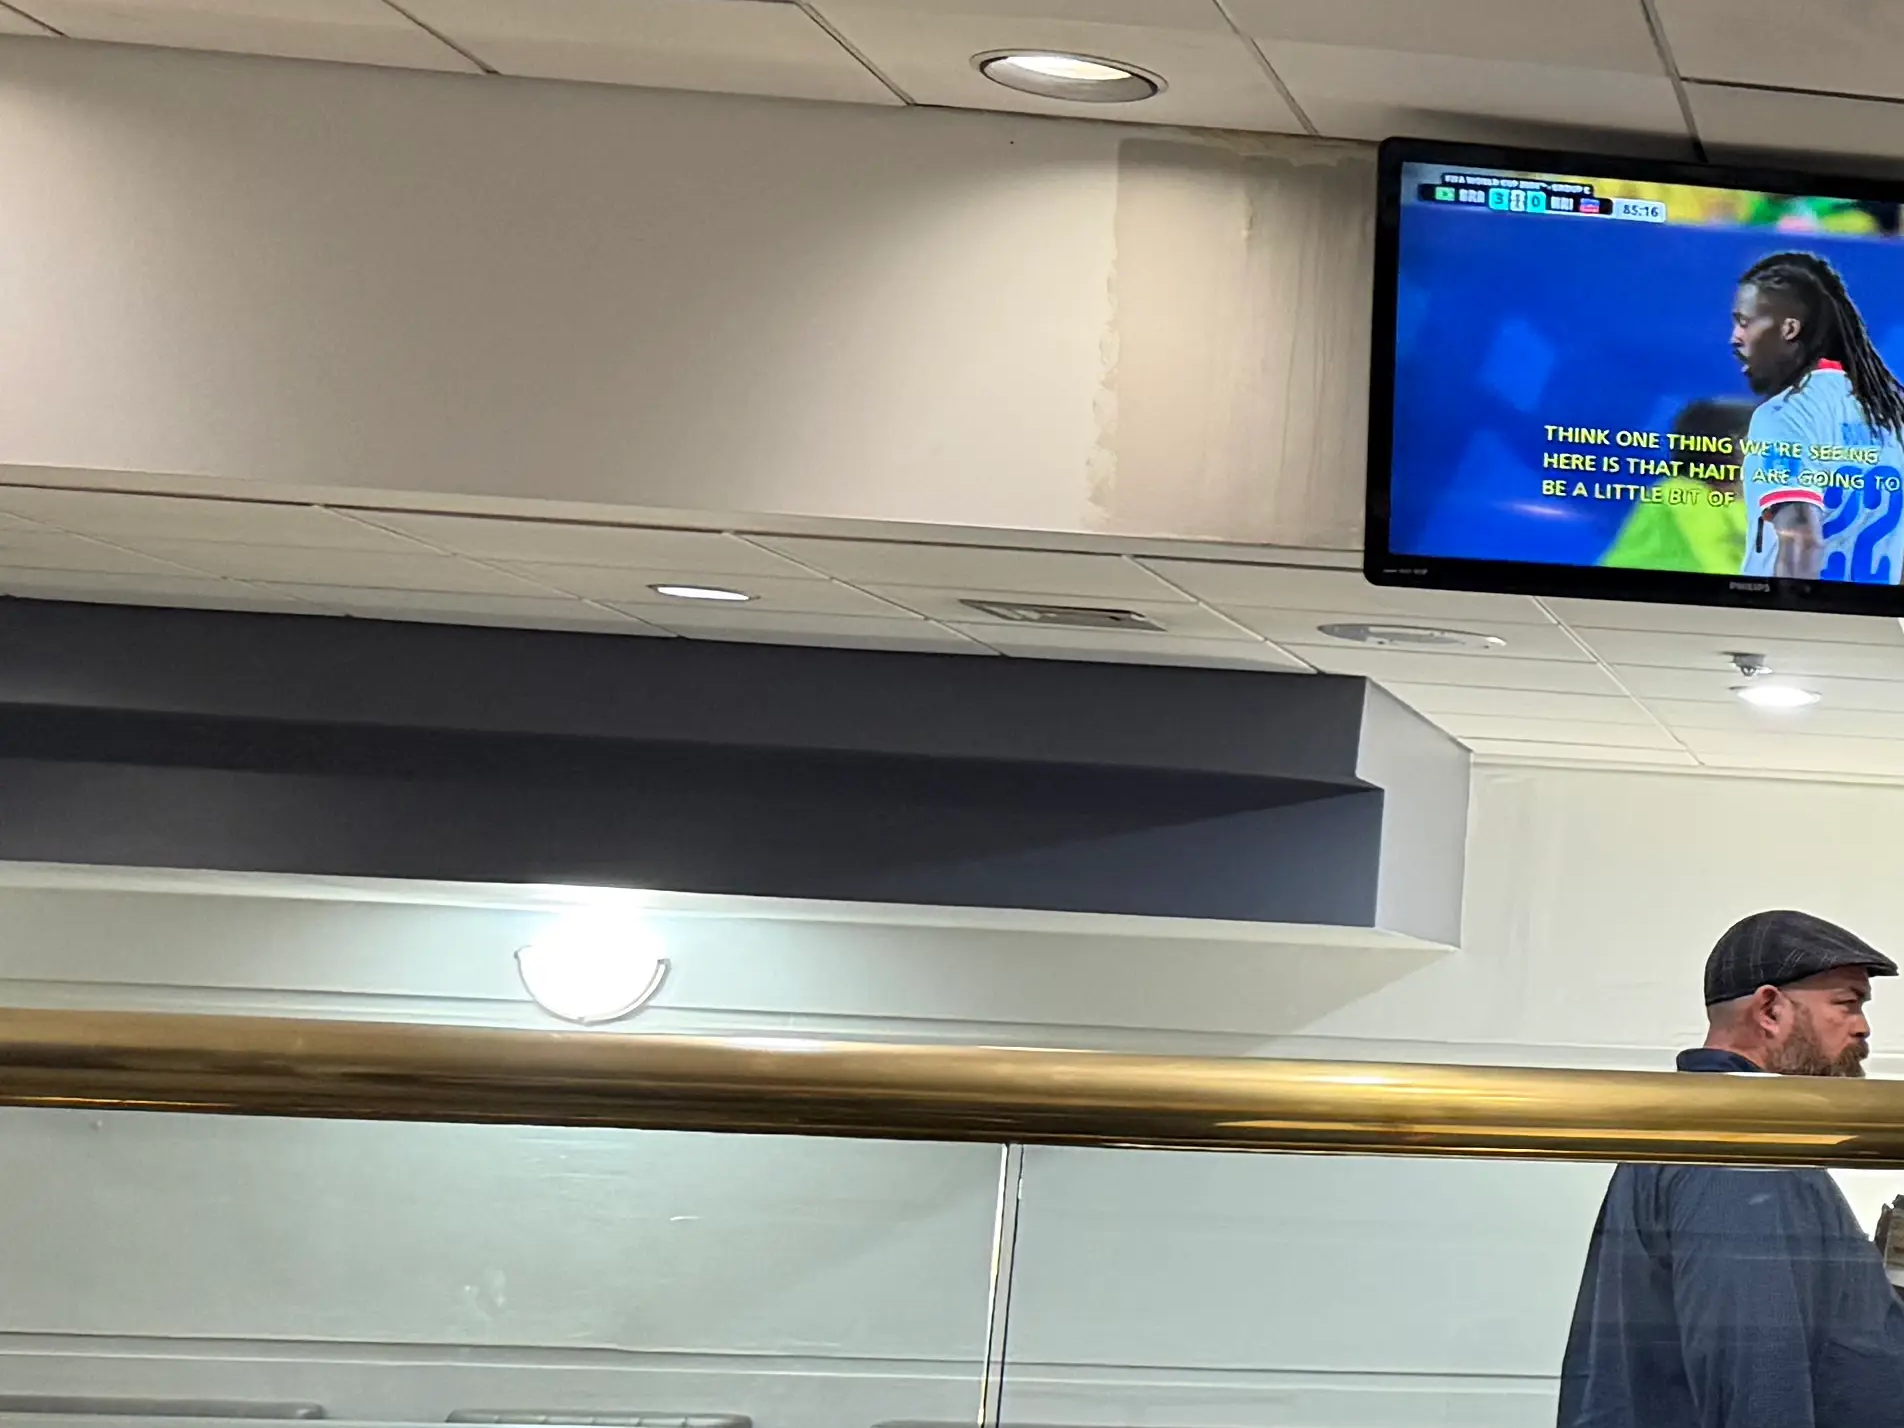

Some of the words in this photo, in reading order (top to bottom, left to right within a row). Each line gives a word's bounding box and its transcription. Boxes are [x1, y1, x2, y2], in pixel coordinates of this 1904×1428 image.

[1623, 204, 1659, 218] 85:16
[1544, 425, 1610, 445] THINK
[1616, 430, 1660, 449] ONE
[1666, 434, 1733, 454] THING
[1739, 439, 1803, 458] WE'RE
[1543, 452, 1597, 472] HERE
[1602, 456, 1619, 472] IS
[1627, 458, 1684, 477] THAT
[1689, 462, 1744, 481] HAITI
[1752, 468, 1791, 485] ARE
[1797, 468, 1864, 489] GOING
[1874, 475, 1901, 491] TO
[1542, 479, 1567, 496] BE
[1572, 481, 1589, 497] A
[1594, 483, 1663, 503] LITTLE
[1668, 489, 1701, 505] BIT
[1707, 490, 1735, 507] OF
